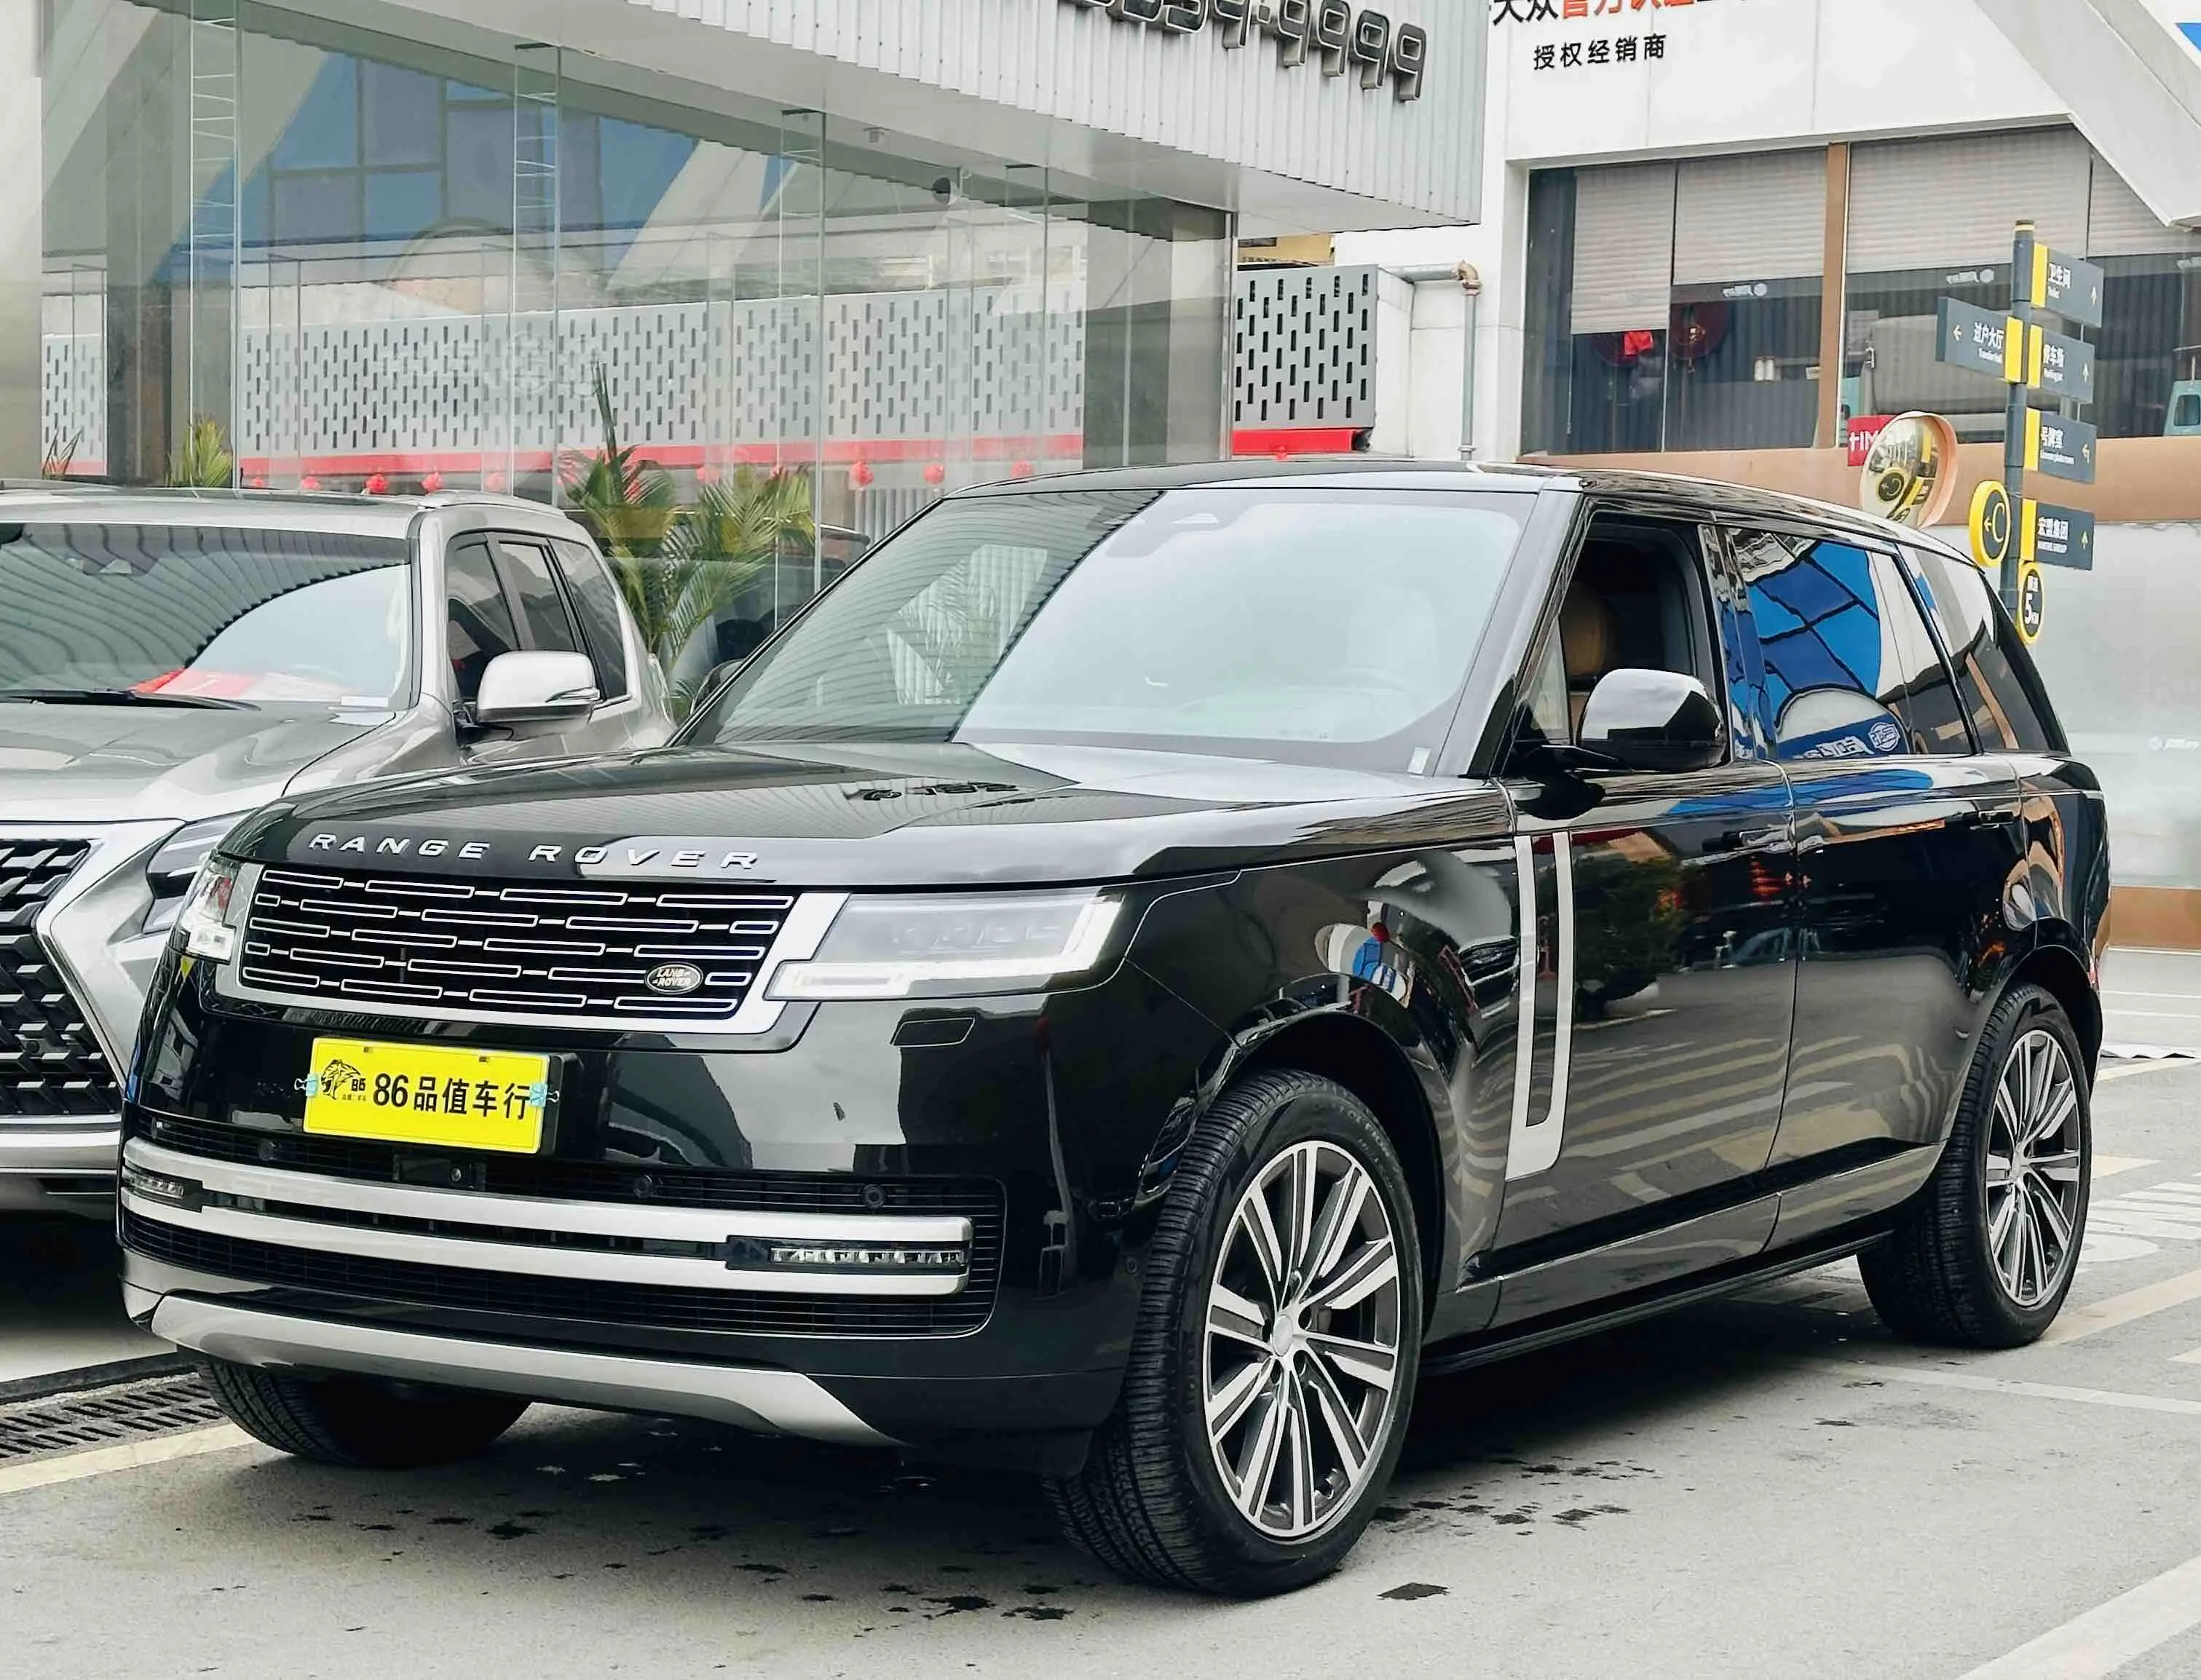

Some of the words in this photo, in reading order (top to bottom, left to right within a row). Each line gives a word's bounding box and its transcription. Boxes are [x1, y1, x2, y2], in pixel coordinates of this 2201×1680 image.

[1533, 33, 1667, 70] 授权经销商
[309, 833, 490, 860] RANGE
[528, 844, 759, 868] ROVER
[373, 1073, 531, 1120] 86品值车行
